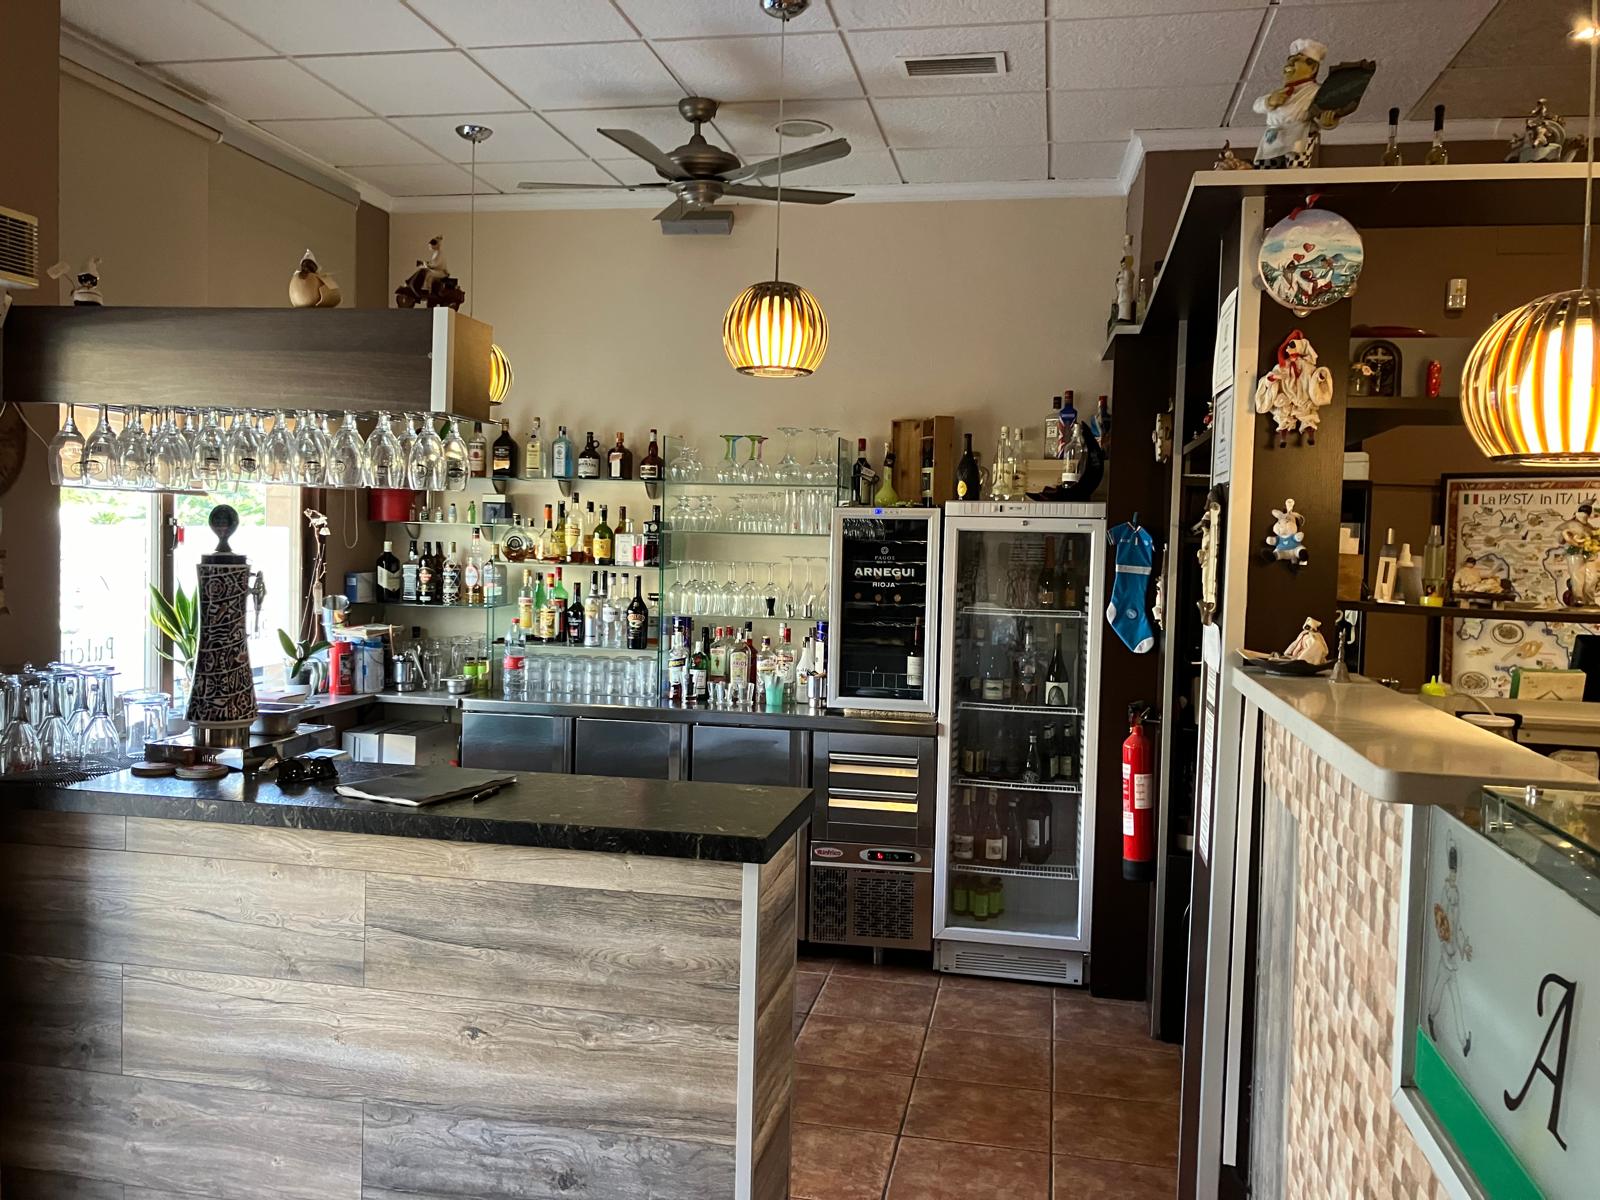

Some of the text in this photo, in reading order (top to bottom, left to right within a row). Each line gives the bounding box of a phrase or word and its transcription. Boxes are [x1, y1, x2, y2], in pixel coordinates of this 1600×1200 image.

[1481, 494, 1496, 505] La
[854, 567, 915, 577] ARNEGUI
[1503, 973, 1577, 1151] A
